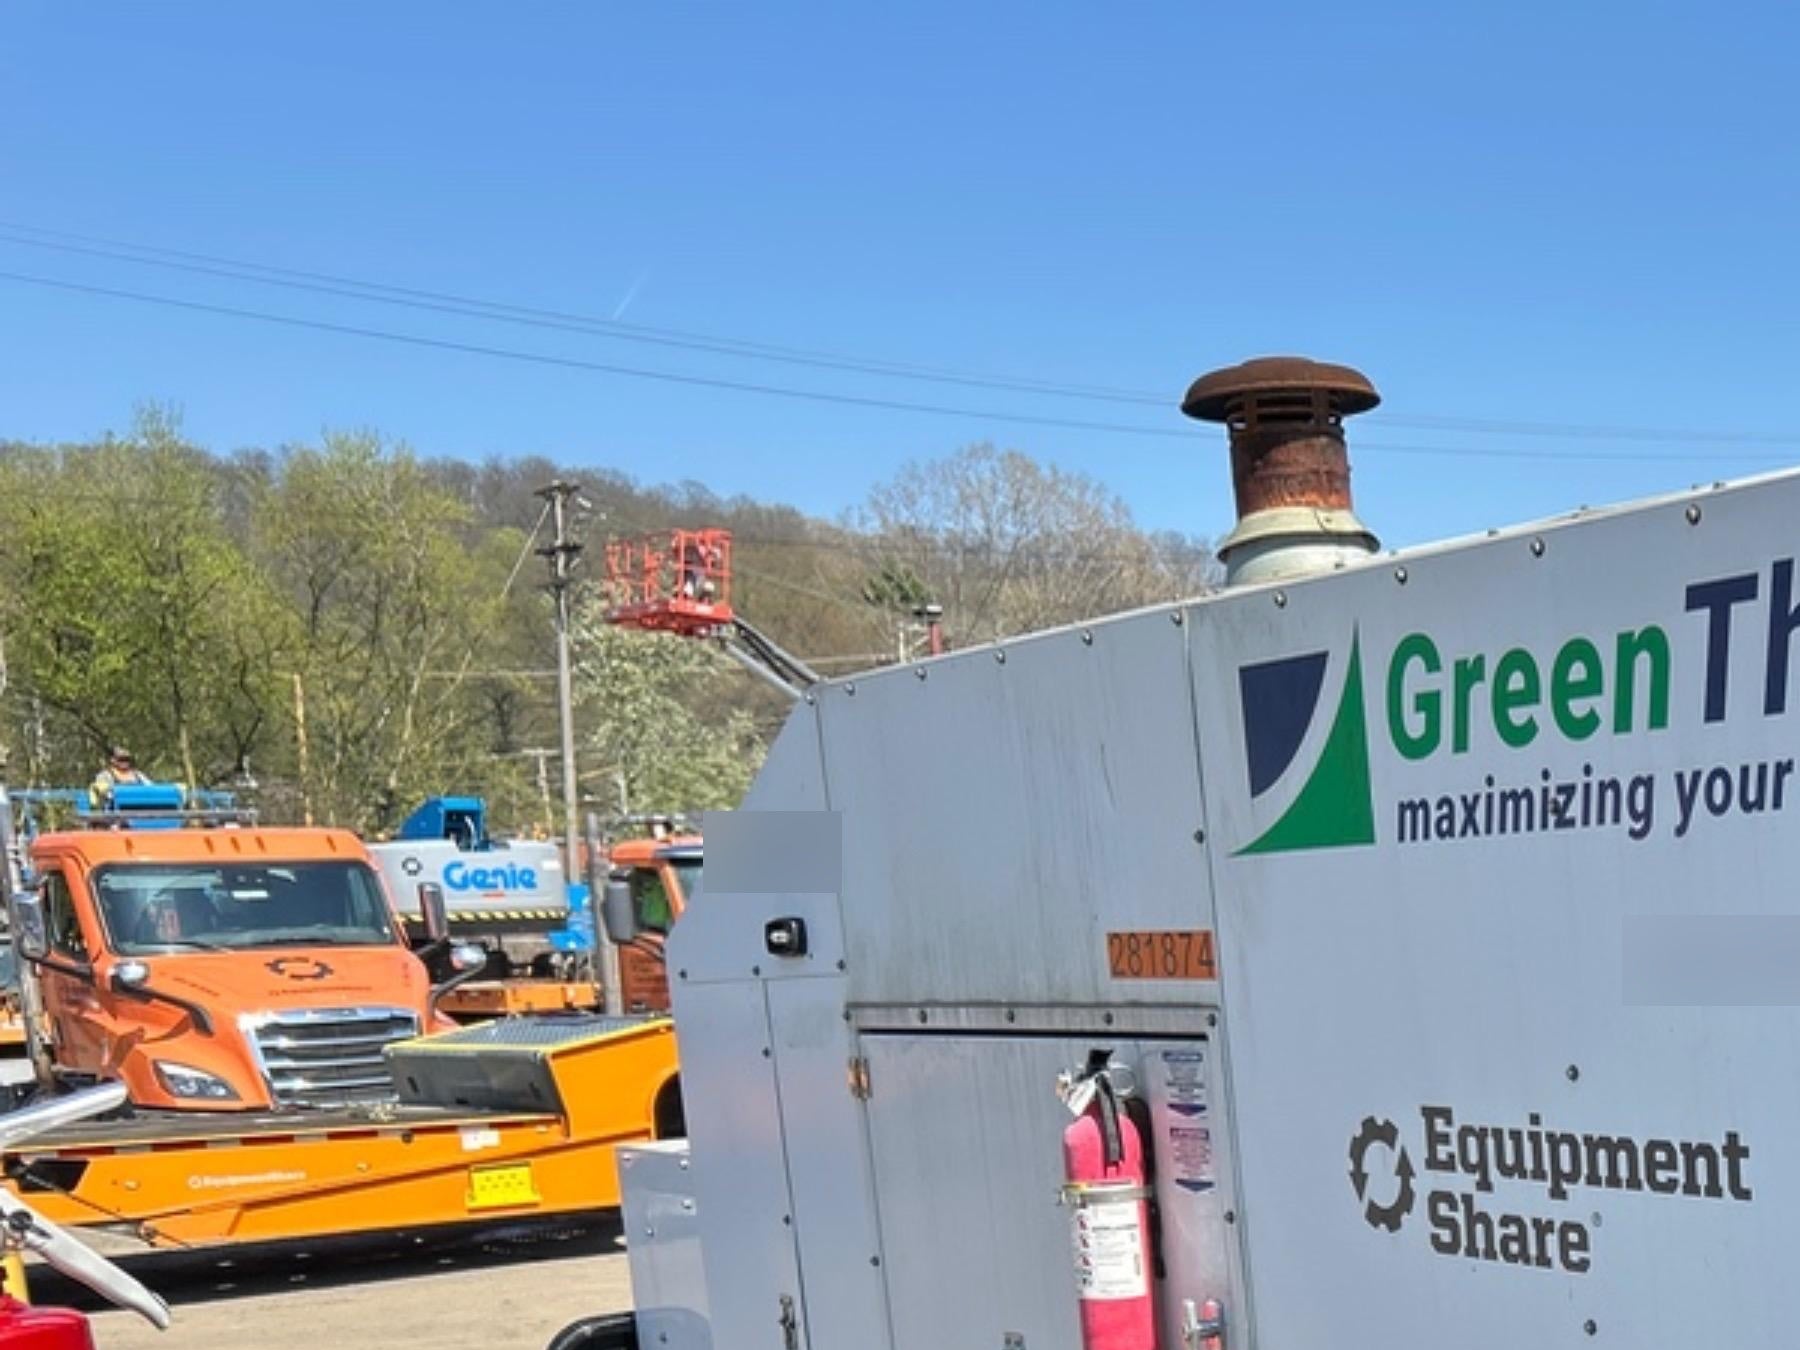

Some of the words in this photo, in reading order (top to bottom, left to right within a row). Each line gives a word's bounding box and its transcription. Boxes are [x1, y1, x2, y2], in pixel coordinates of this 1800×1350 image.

[1397, 762, 1655, 842] maximizing
[1673, 756, 1793, 838] your
[443, 861, 537, 891] Genie
[1109, 931, 1215, 978] 281874
[1420, 1105, 1752, 1201] Equipment
[1427, 1190, 1592, 1273] Share
